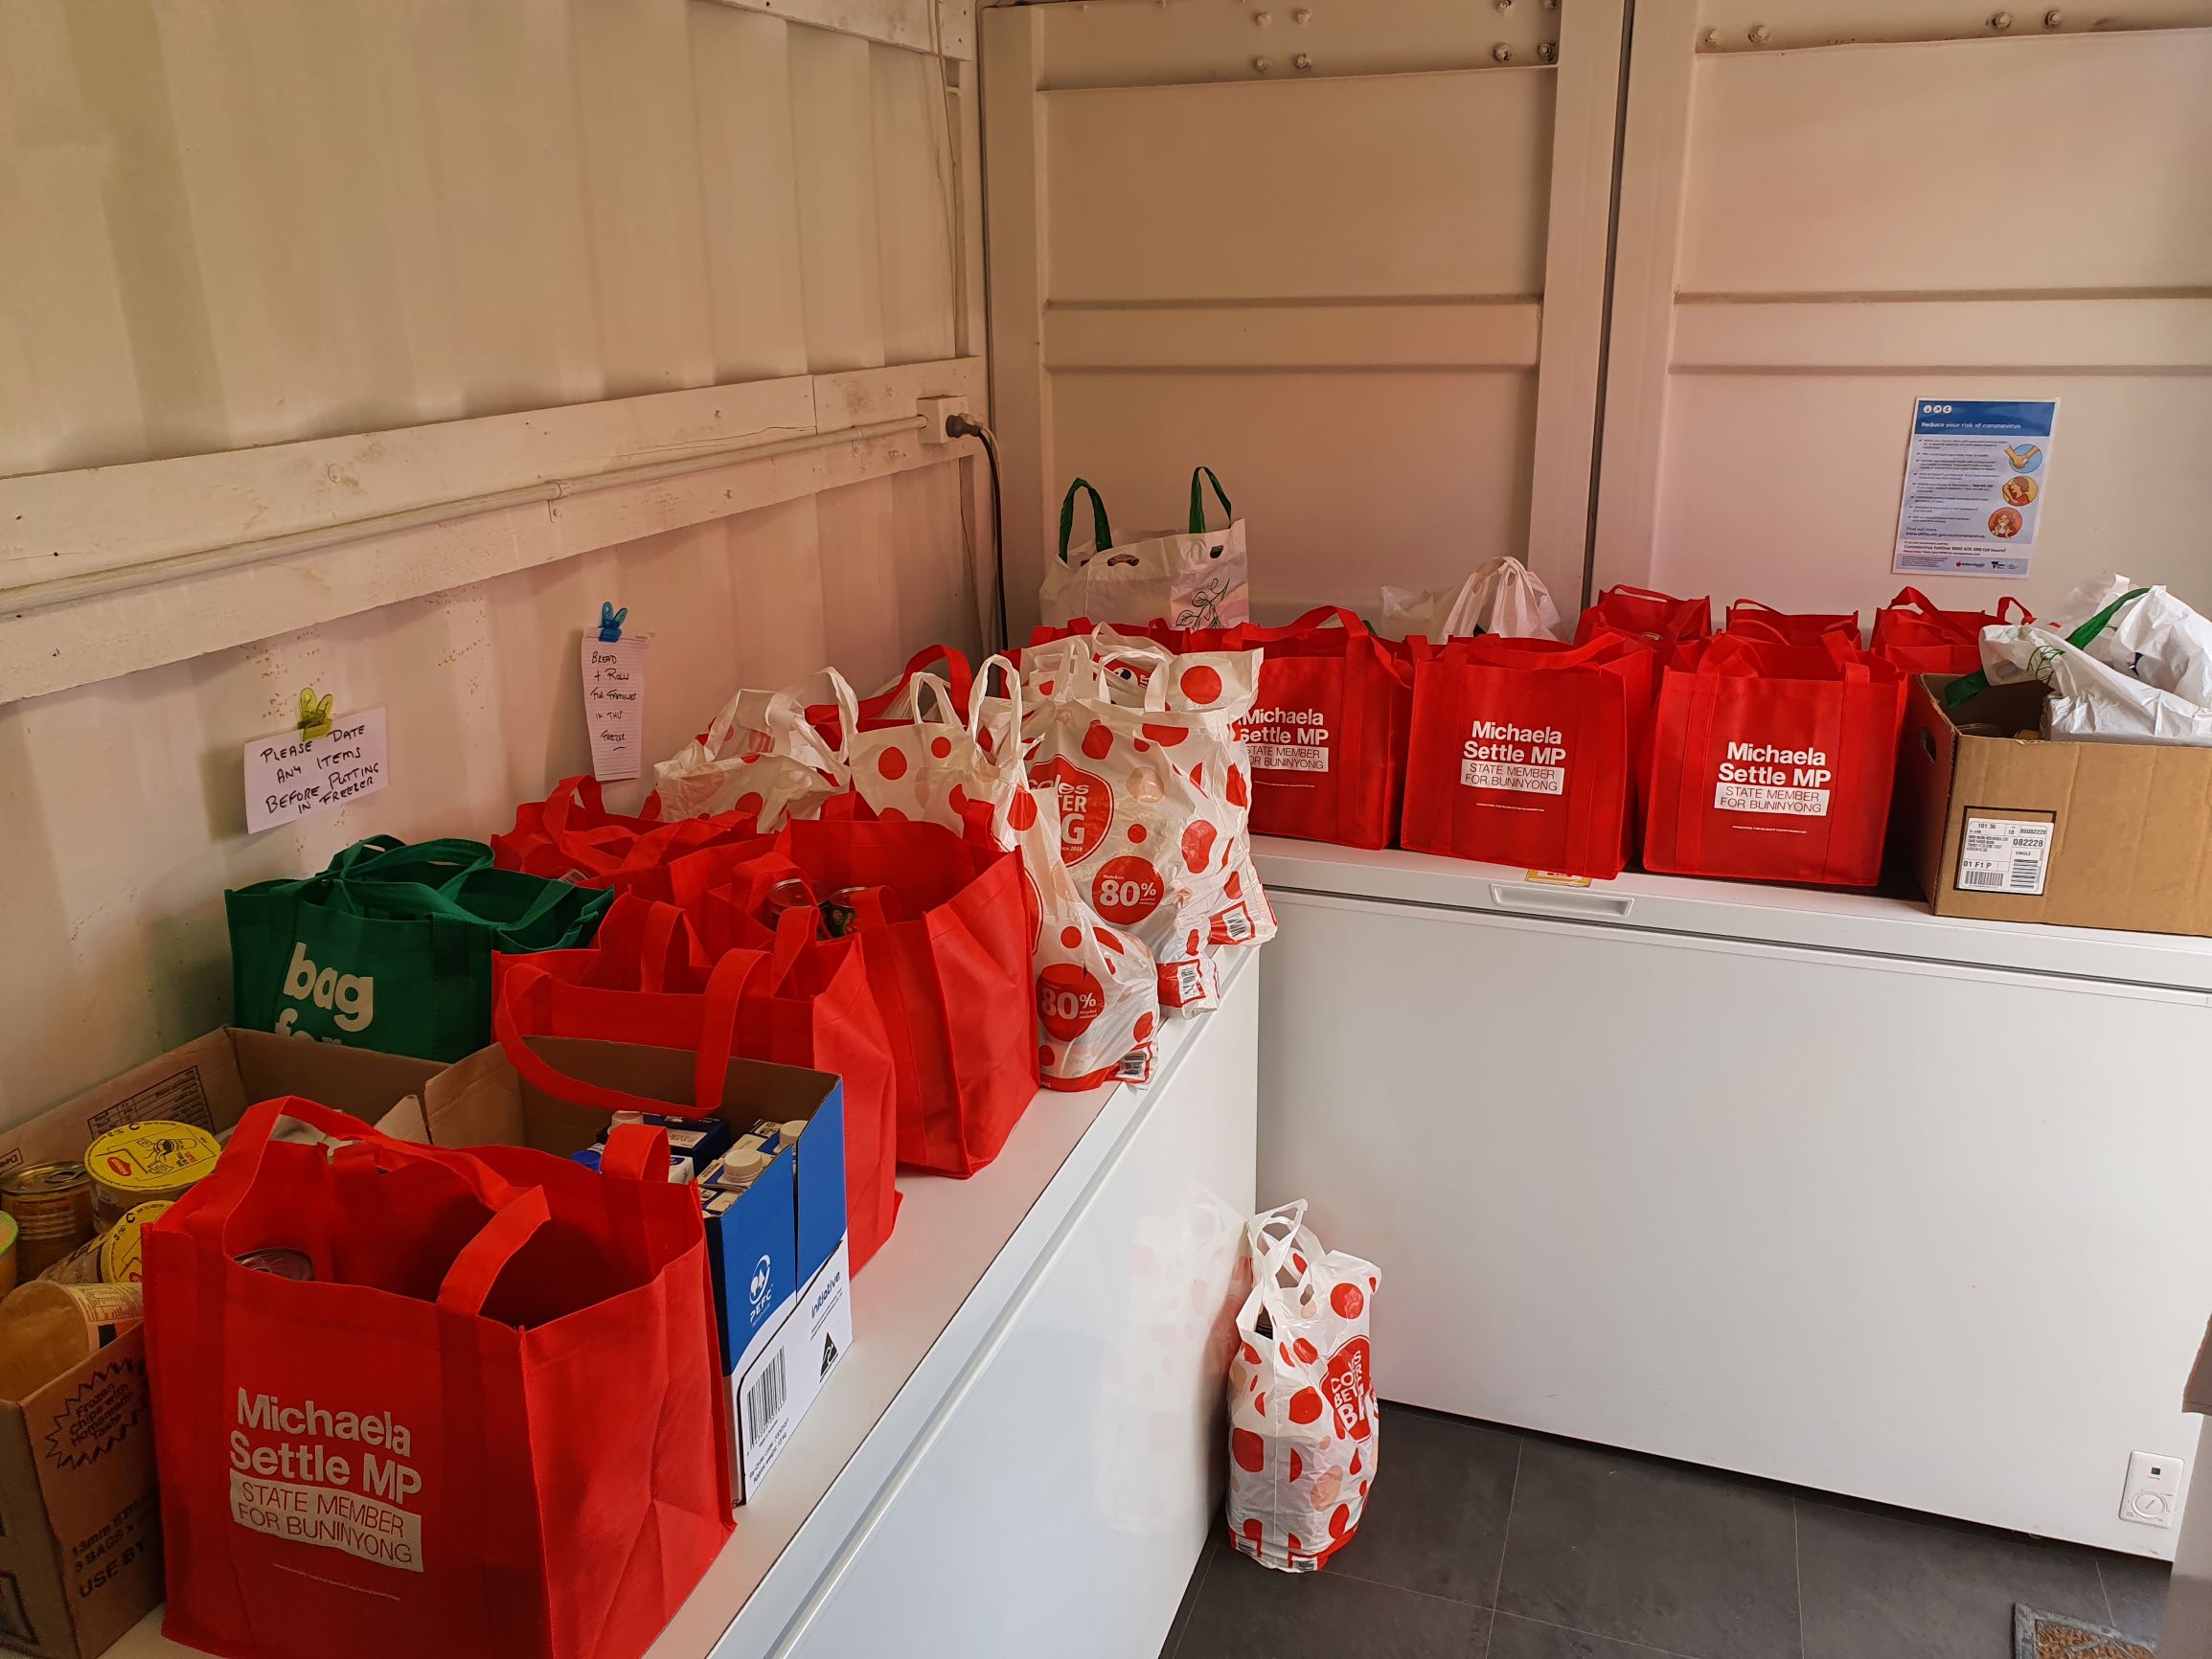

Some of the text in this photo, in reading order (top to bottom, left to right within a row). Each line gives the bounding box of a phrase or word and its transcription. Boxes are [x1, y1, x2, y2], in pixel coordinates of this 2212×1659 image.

[1242, 707, 1324, 726] Michaela
[261, 724, 366, 763] PLEASE DATE
[1240, 726, 1329, 745] Settle MP
[1471, 720, 1562, 745] Michaela
[277, 746, 361, 784] ANY ITEMS
[1246, 745, 1320, 759] STATE MEMBER
[1249, 757, 1324, 769] OR BUNINYONG
[1463, 740, 1566, 765] Settle MP
[1726, 741, 1826, 766] Michaela
[1465, 773, 1488, 784] FOR
[1470, 762, 1555, 780] STATE MEMBER
[1718, 762, 1832, 787] Settle MP
[265, 762, 379, 814] BEFORE PUTTING
[298, 776, 374, 814] IN FREEZER
[1725, 785, 1819, 802] STATE MEMBER
[1720, 796, 1822, 813] FOR BUNINYONG
[2013, 838, 2044, 848] 082228
[1099, 879, 1157, 907] 80%
[283, 942, 374, 1033] bag
[1041, 987, 1097, 1020] 80%
[750, 1288, 772, 1323] PEFC
[238, 1386, 411, 1458] Michaela
[230, 1430, 422, 1505] Settle MP
[241, 1481, 404, 1538] STATE MEMBER
[238, 1502, 413, 1564] FOR BUNINYONG
[80, 1559, 119, 1599] USE
